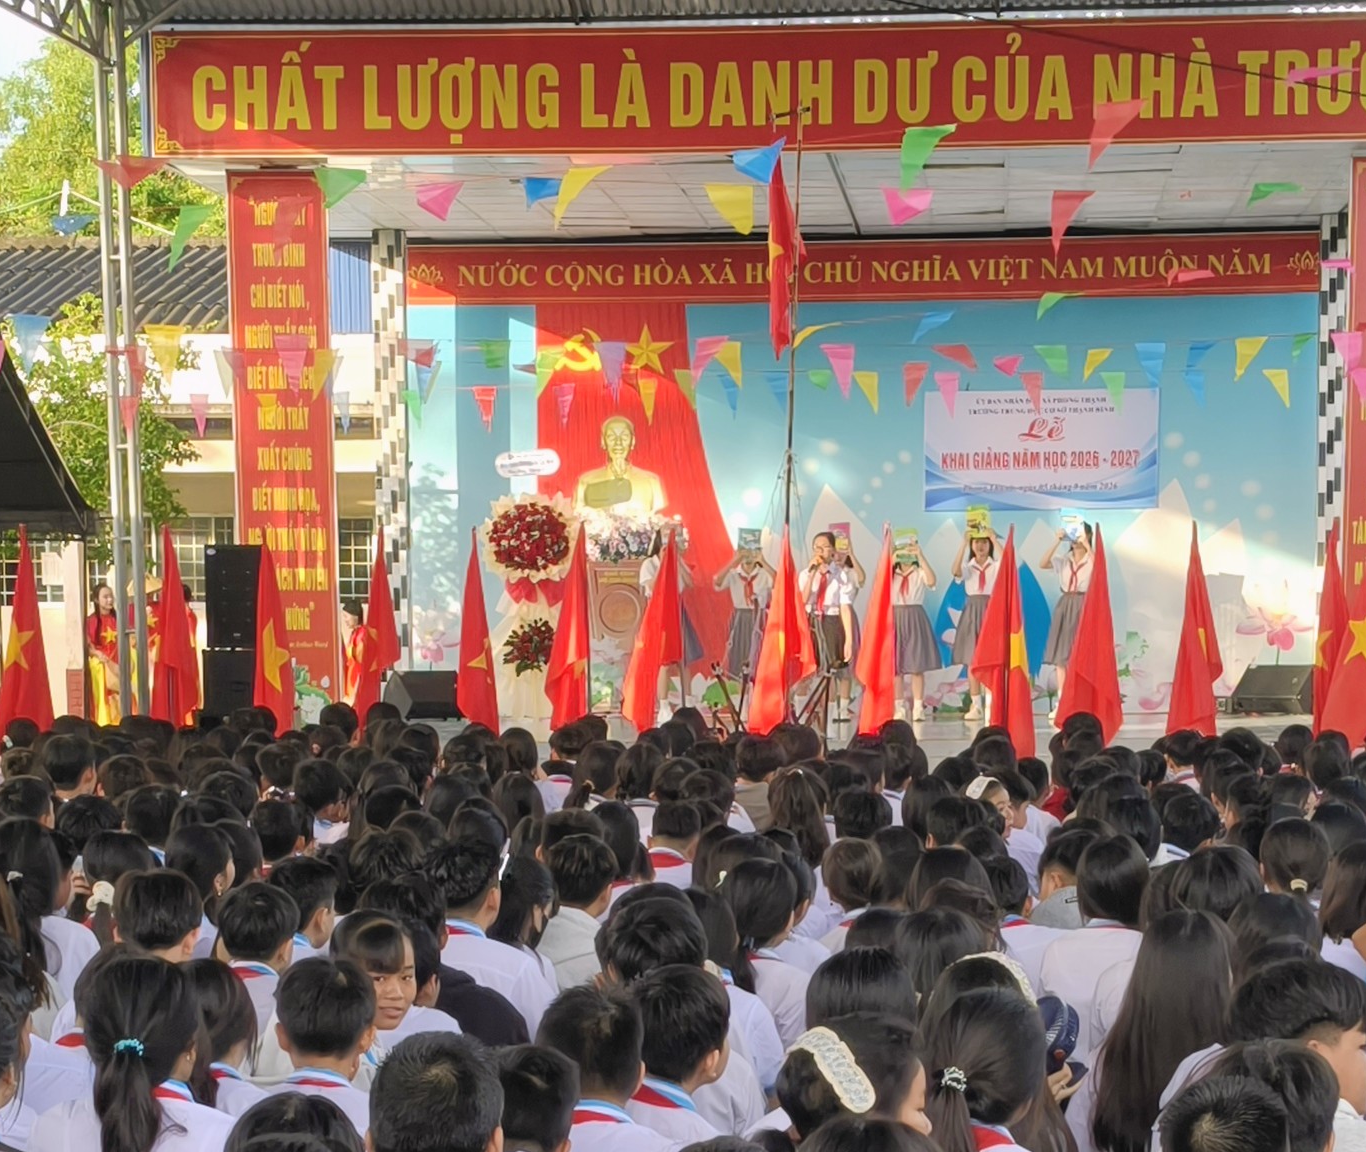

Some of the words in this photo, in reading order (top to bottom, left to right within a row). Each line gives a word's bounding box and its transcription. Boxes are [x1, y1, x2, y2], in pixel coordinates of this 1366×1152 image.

[191, 41, 345, 131] CHẤT
[363, 56, 560, 144] LƯỢNG
[581, 48, 650, 129] LÀ
[669, 59, 833, 127] DANH
[952, 33, 1073, 122] CỦA
[1093, 38, 1219, 121] NHÀ
[457, 257, 538, 287] NƯỚC
[545, 260, 624, 292] CỘNG
[634, 257, 693, 286] HÒA
[698, 258, 737, 285] XÃ
[804, 254, 862, 284] CHỦ
[871, 254, 961, 283] NGHĨA
[968, 255, 1034, 286] VIỆT
[1040, 256, 1104, 280] NAM
[1113, 248, 1199, 279] MUÔN
[1208, 247, 1271, 276] NĂM
[267, 276, 287, 308] BIẾT
[245, 318, 273, 349] NGƯỜI
[247, 358, 267, 389] BIẾT
[1018, 416, 1066, 442] Lễ
[257, 439, 280, 471] XUẤT
[941, 451, 970, 470] KHAI
[973, 446, 1010, 470] GIẢNG
[1013, 448, 1041, 470] NĂM
[1043, 450, 1067, 473] HỌC
[1070, 450, 1100, 469] 2026
[252, 480, 272, 511] BIẾT
